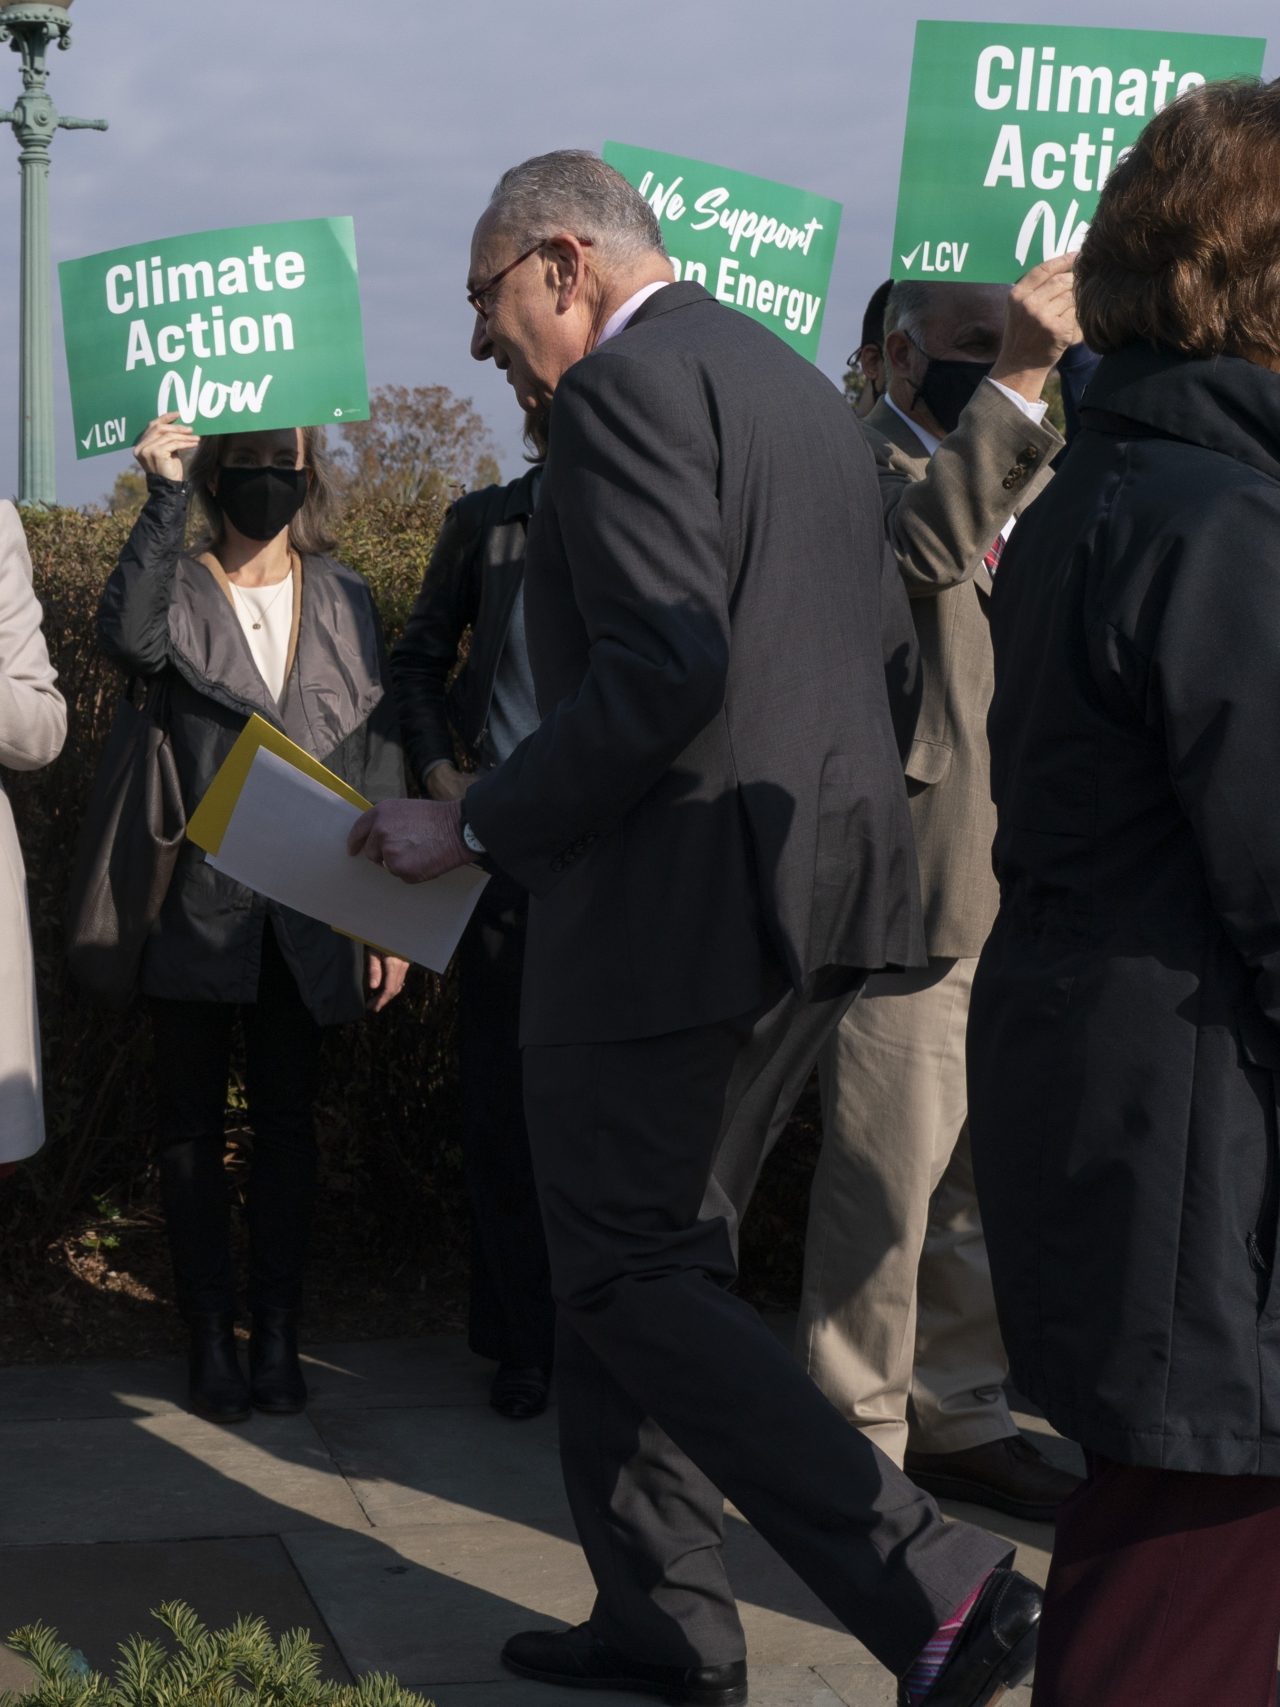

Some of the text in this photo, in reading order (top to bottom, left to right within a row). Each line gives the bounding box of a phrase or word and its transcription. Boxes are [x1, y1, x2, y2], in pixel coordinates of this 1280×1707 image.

[983, 124, 1135, 192] Acti
[638, 170, 824, 258] We Support
[105, 245, 306, 315] Climate
[921, 241, 969, 273] LCV
[715, 256, 821, 335] Energy
[125, 305, 295, 371] Action
[157, 364, 273, 424] Now
[95, 417, 126, 448] LCV
